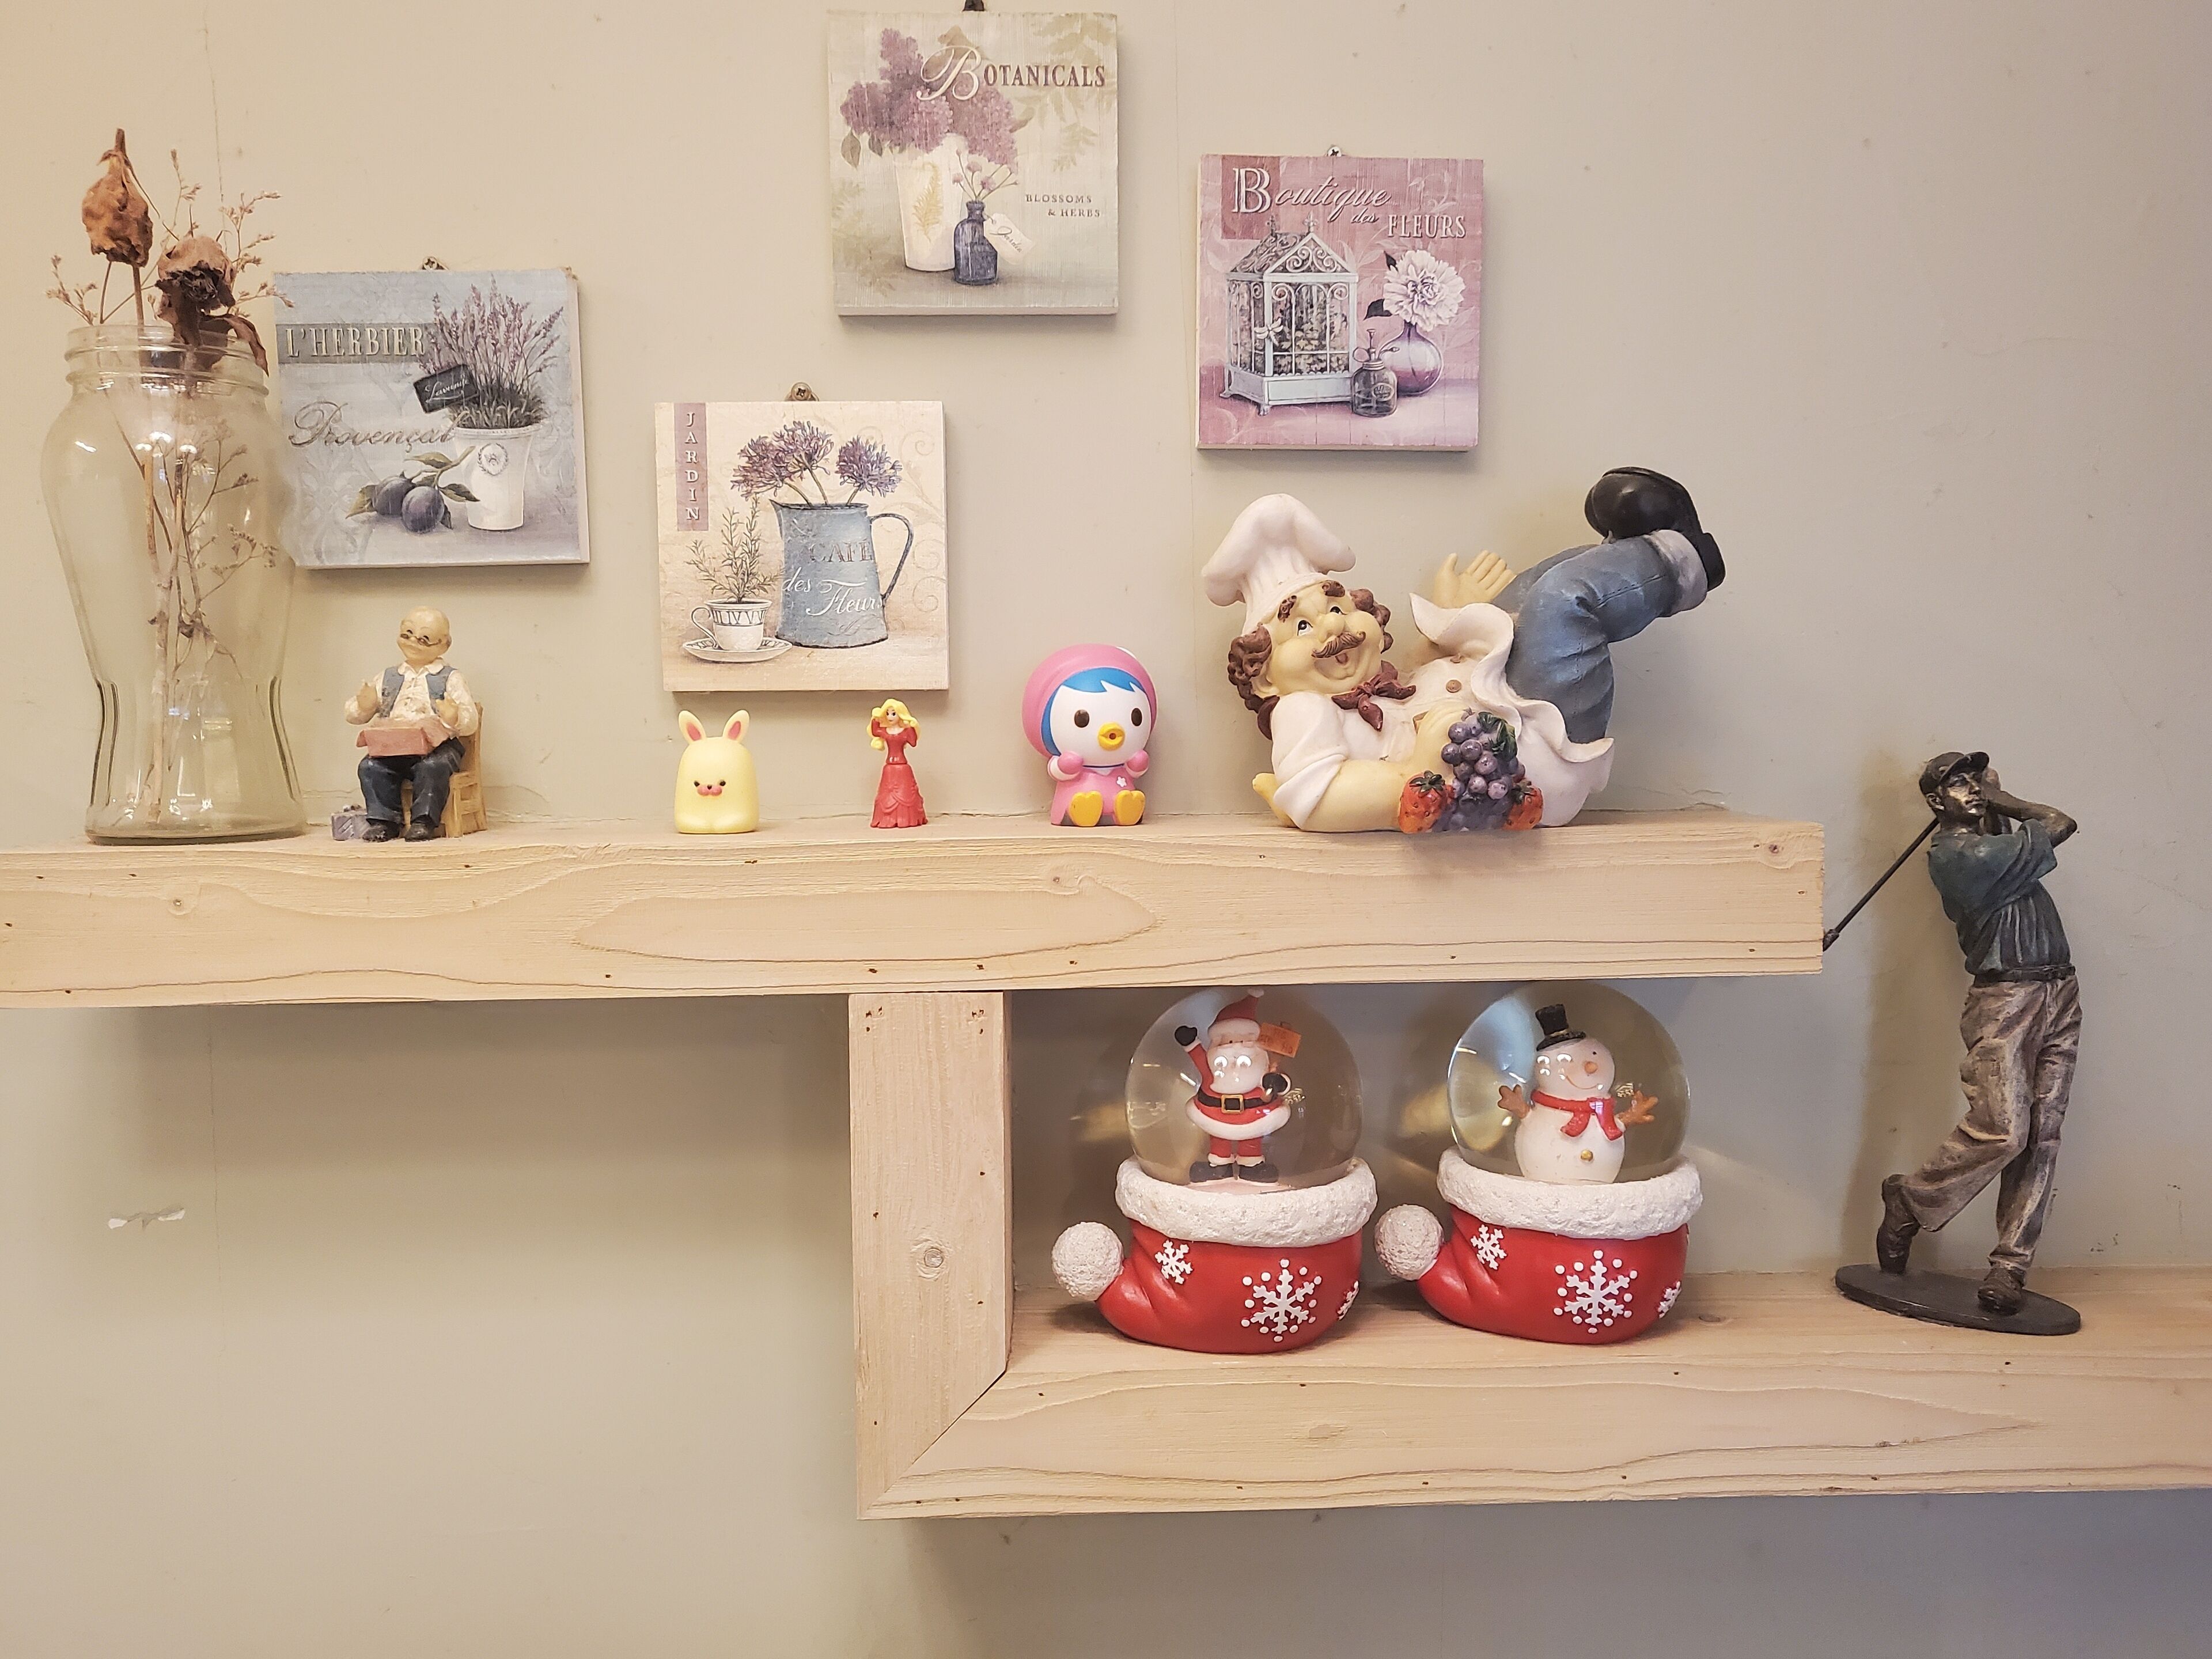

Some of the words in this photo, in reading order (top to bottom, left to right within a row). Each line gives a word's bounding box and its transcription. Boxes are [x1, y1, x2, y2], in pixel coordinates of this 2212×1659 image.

[916, 46, 1105, 100] BOTANICALS
[1025, 194, 1092, 203] BLOSSOMS
[1232, 167, 1392, 222] Boutique
[1048, 208, 1056, 216] &
[1060, 209, 1100, 217] HERBS
[1350, 209, 1380, 224] des
[1387, 214, 1467, 238] FLEURS
[286, 327, 425, 357] L'HERBIER
[288, 401, 469, 453] Provençal
[685, 412, 699, 521] JARDIN
[782, 567, 811, 592] des
